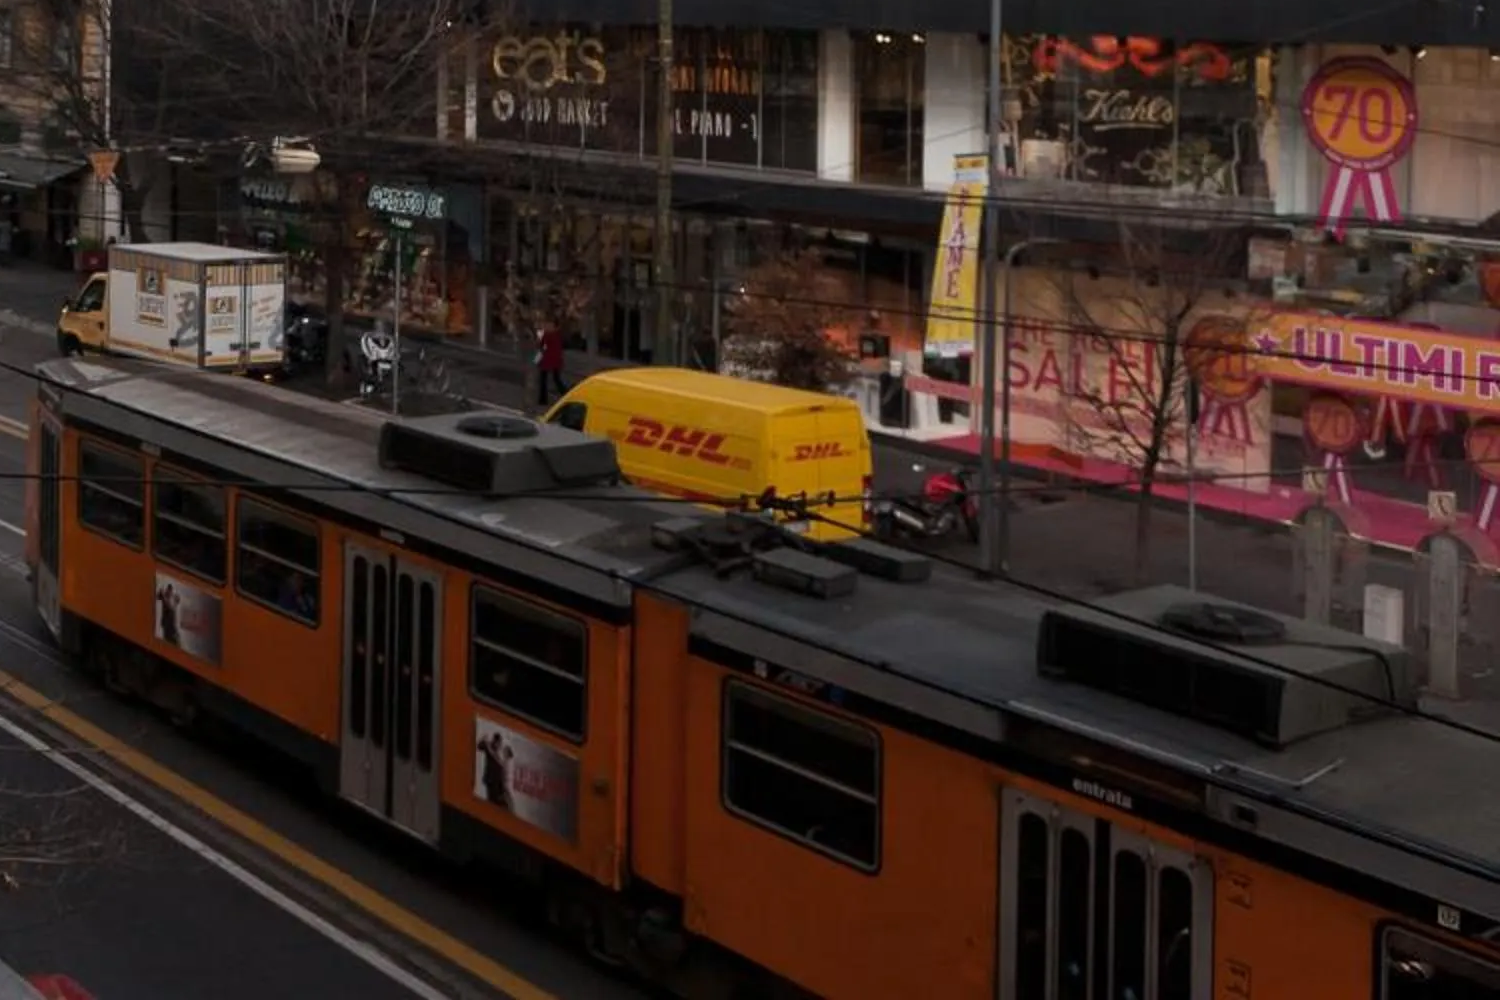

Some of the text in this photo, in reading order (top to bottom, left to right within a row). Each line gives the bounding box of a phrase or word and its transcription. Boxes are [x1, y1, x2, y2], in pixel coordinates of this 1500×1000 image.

[1323, 85, 1393, 144] 70
[1292, 324, 1466, 396] ULTIMI
[624, 416, 731, 467] DHL
[794, 441, 845, 461] DHL
